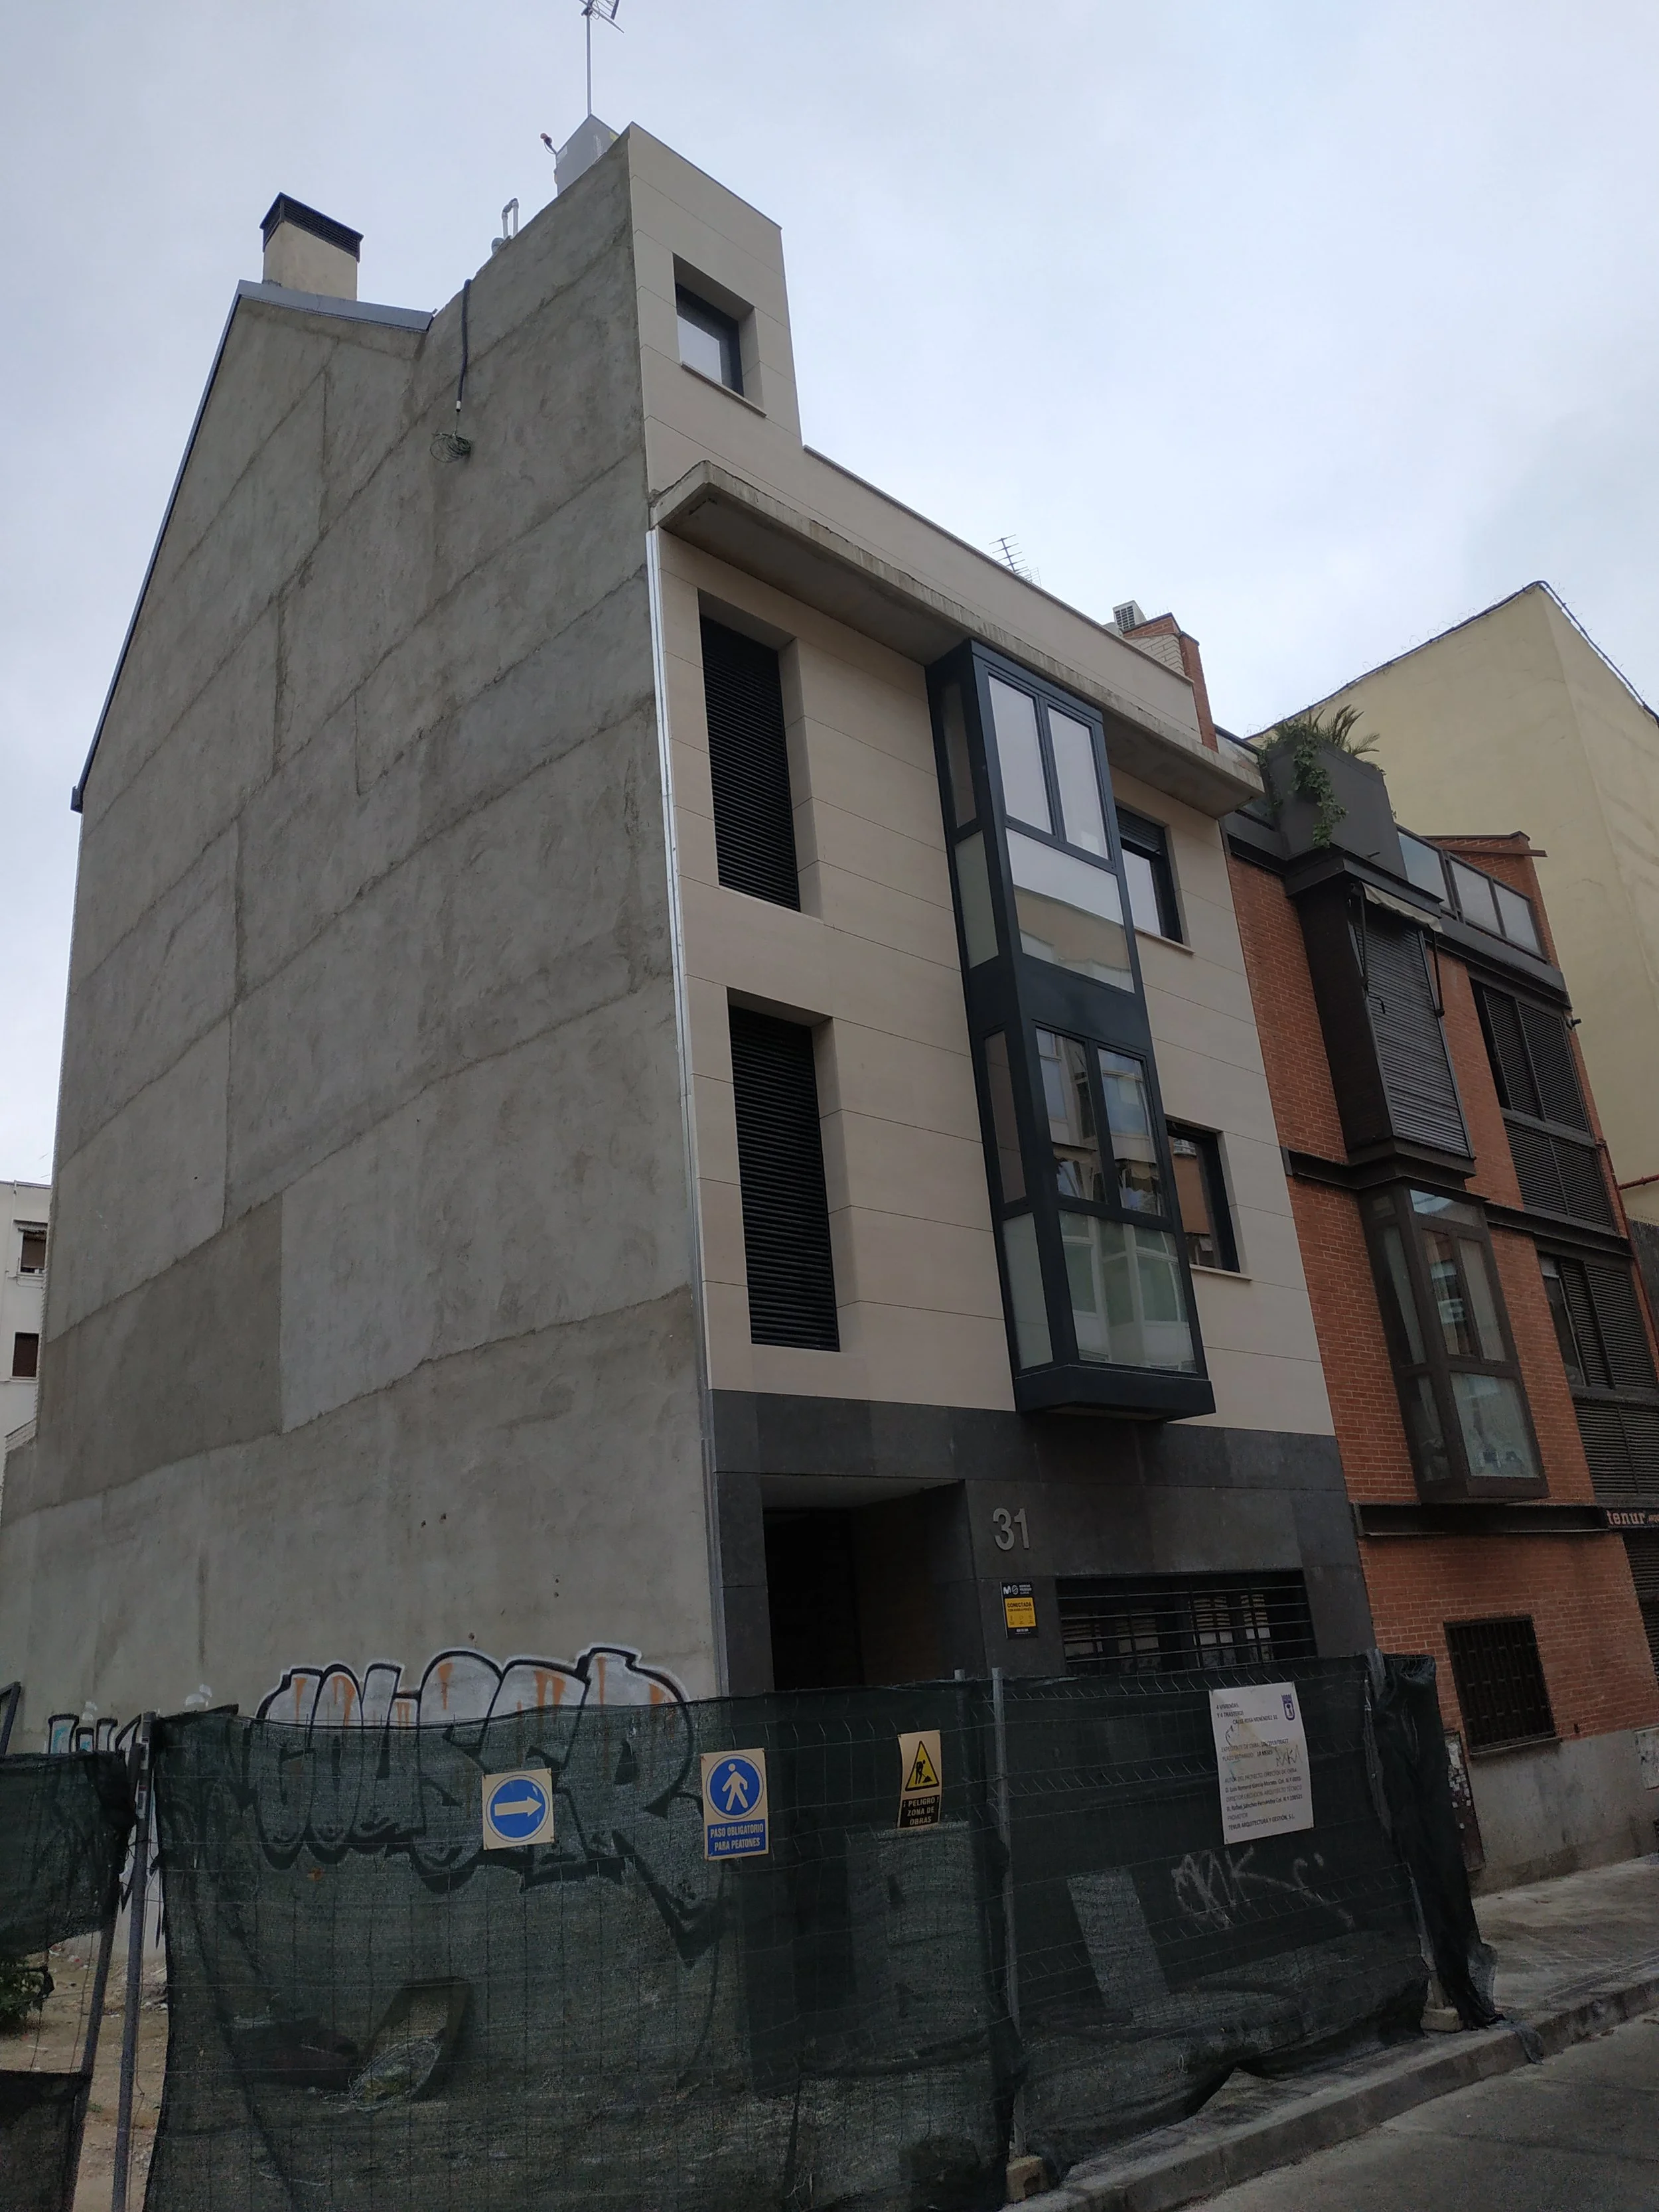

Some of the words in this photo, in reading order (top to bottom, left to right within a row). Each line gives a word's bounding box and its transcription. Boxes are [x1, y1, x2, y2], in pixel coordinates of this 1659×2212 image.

[1606, 1510, 1645, 1524] tenur
[993, 1508, 1029, 1550] 31
[908, 1797, 935, 1807] PELIGRO
[907, 1808, 925, 1817] ZONA
[909, 1816, 932, 1826] OBRAS
[710, 1827, 726, 1838] PASO
[727, 1823, 764, 1836] OBLIGATORIO
[714, 1841, 731, 1852] PARA
[731, 1837, 760, 1849] PEATONES
